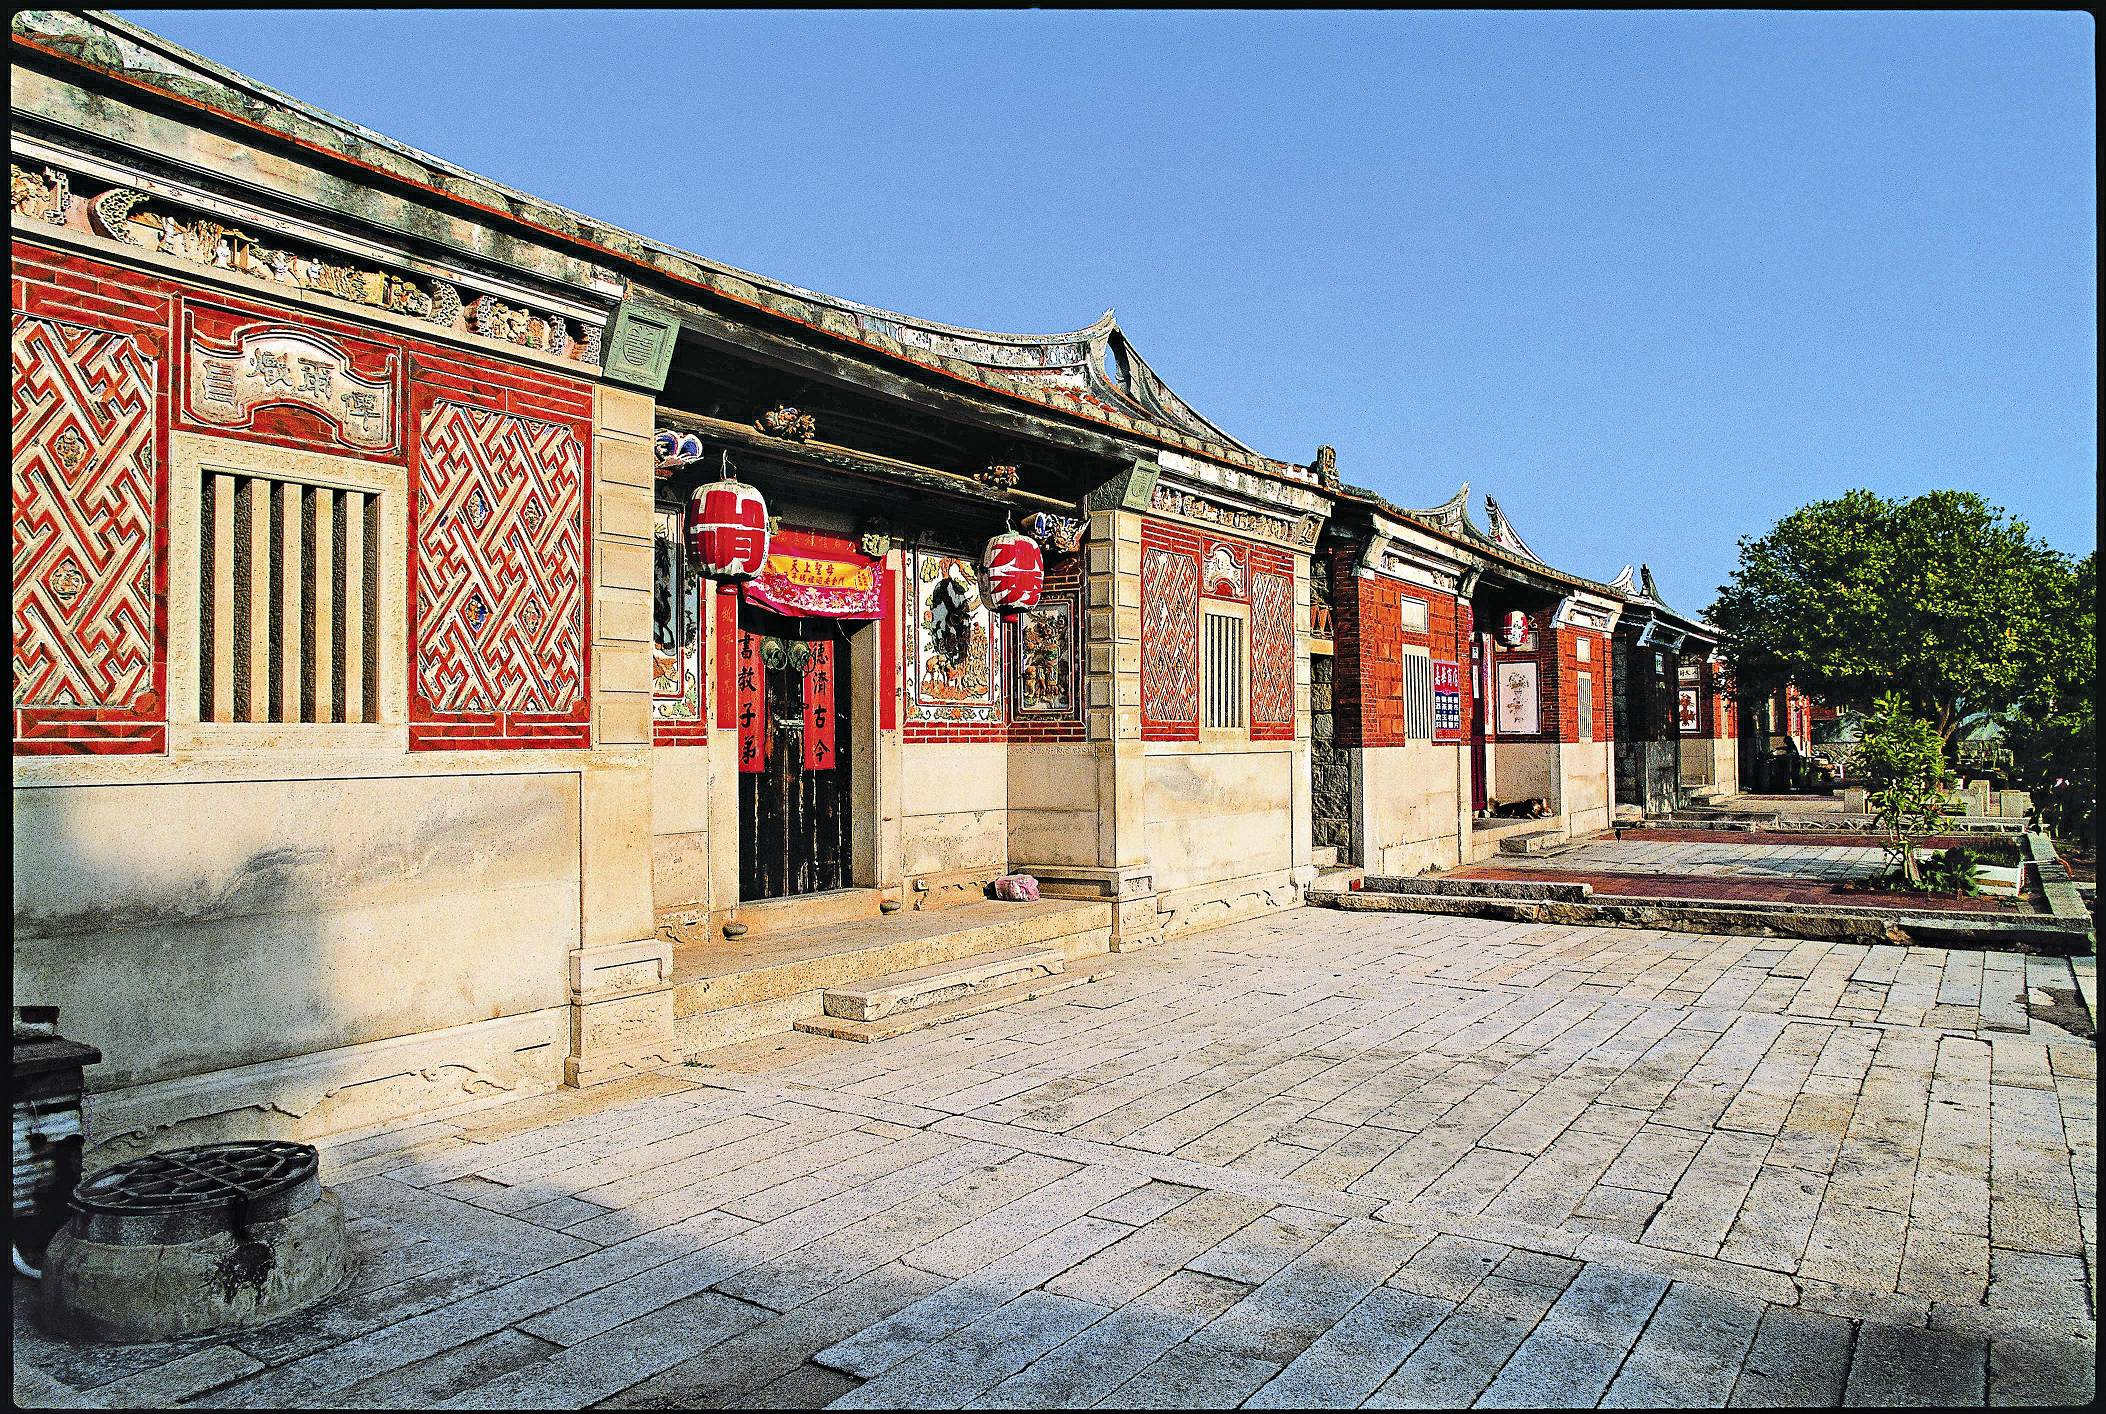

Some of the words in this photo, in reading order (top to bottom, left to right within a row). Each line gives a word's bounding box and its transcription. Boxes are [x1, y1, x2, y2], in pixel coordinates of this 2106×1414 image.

[791, 559, 835, 576] 天上聖母
[738, 635, 757, 764] 書教子弟
[812, 642, 831, 763] 德濟古今
